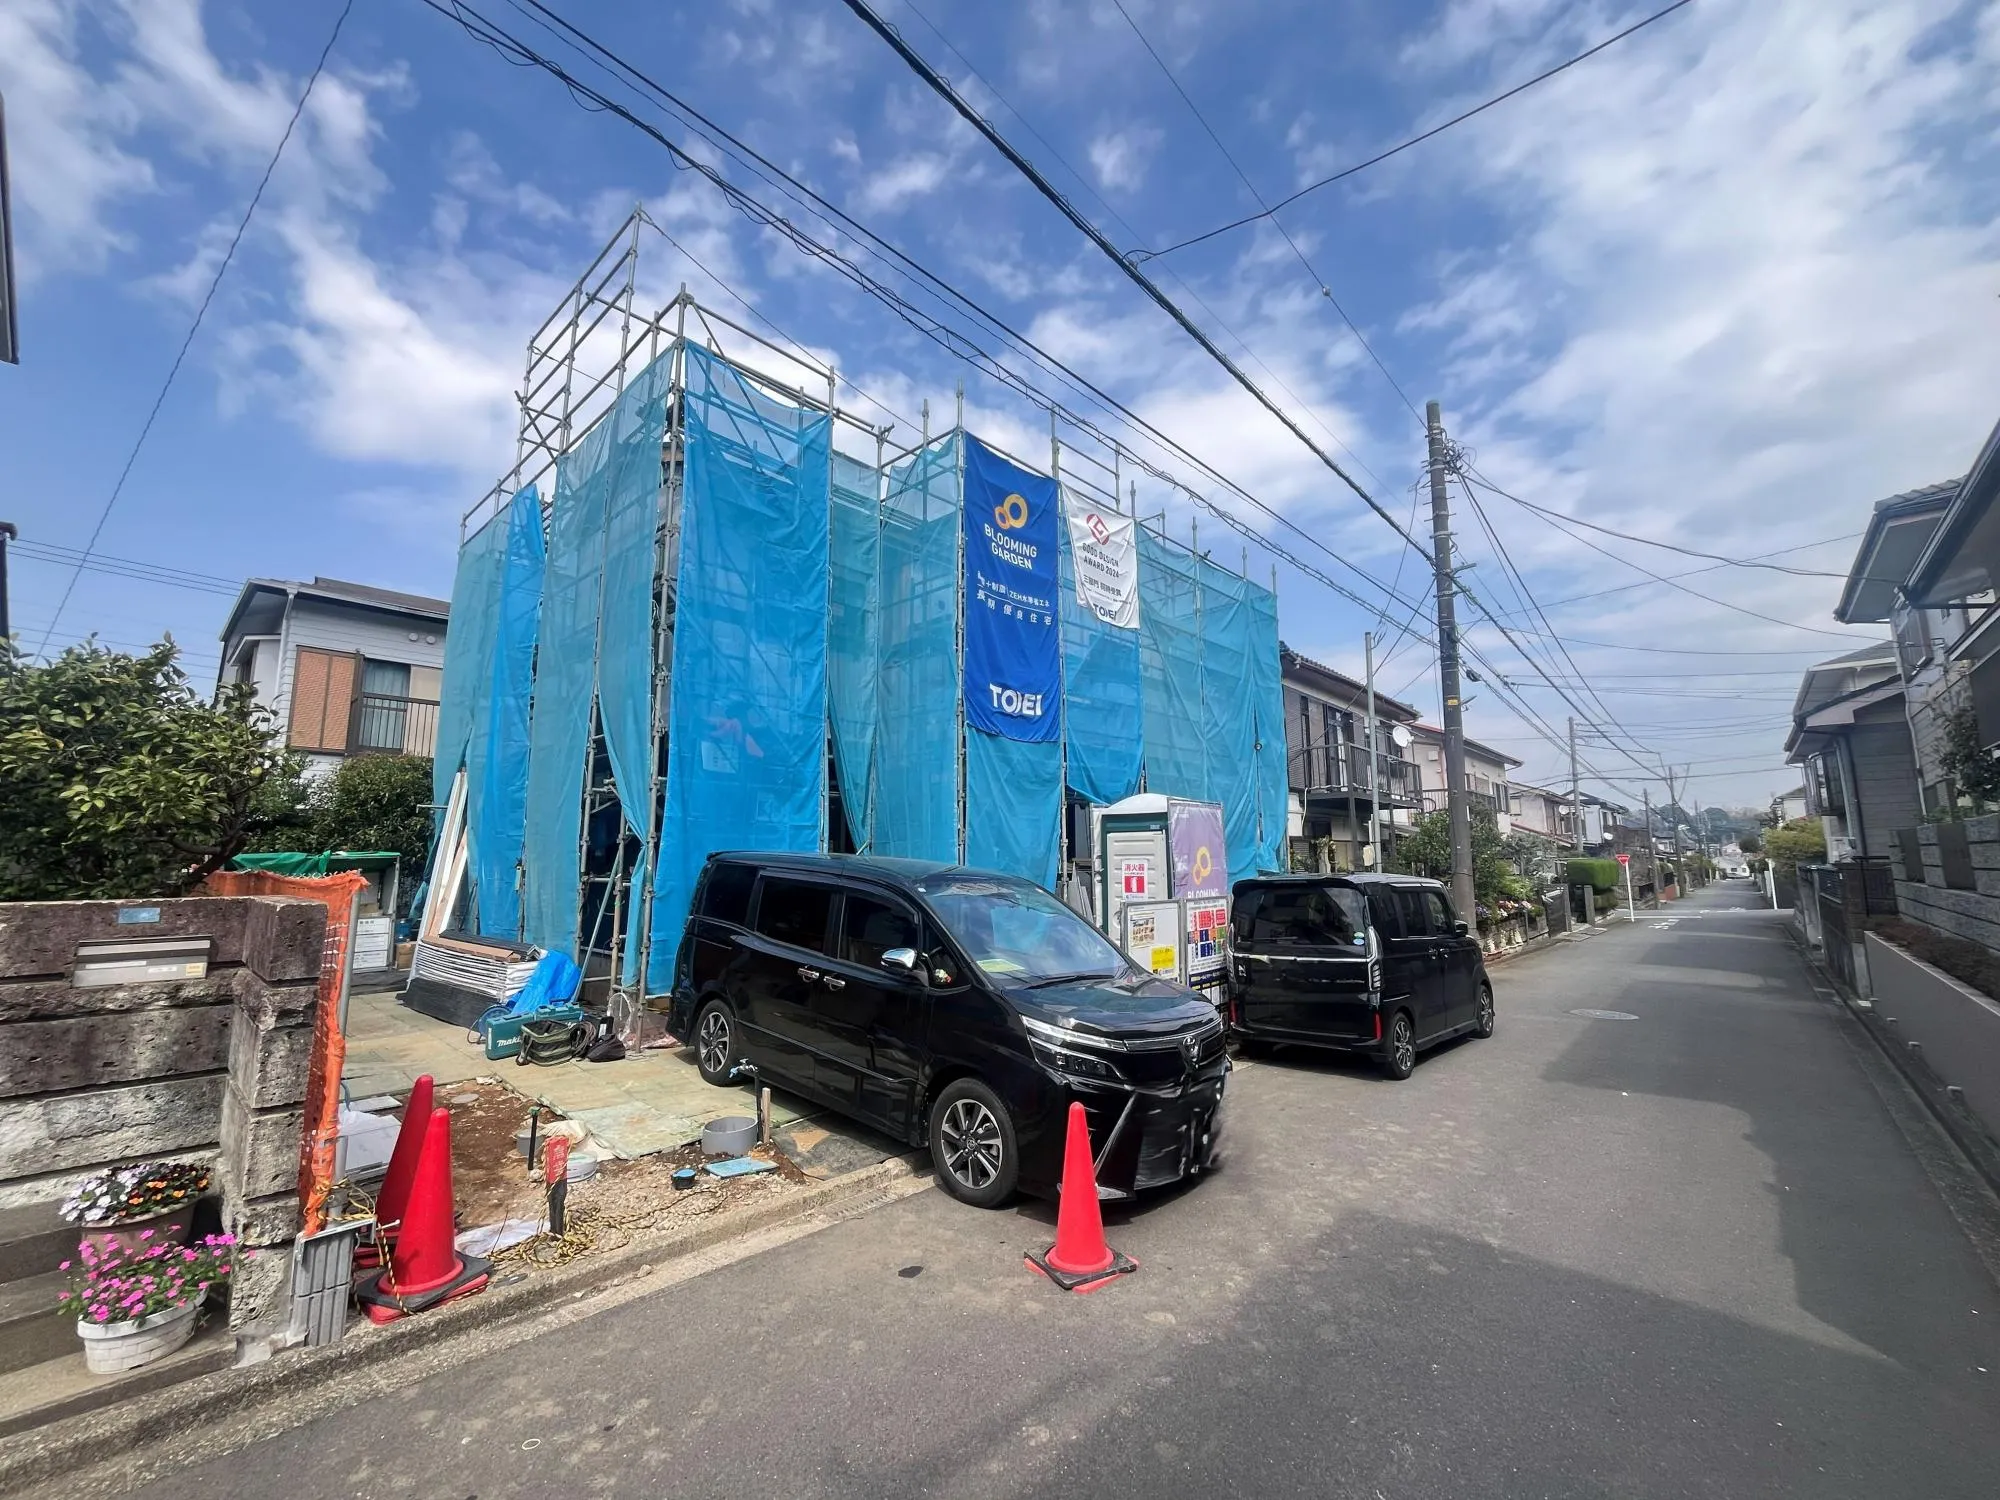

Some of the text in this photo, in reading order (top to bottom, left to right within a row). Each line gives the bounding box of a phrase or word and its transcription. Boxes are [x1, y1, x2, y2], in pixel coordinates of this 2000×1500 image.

[984, 523, 1037, 558] BLOOMING
[1082, 542, 1098, 558] GOOD
[991, 542, 1032, 569] GARDEN
[1083, 556, 1120, 578] AWARD 2024
[989, 682, 1043, 716] TOEI
[1124, 863, 1145, 872] 消火器
[496, 1036, 522, 1048] maki
